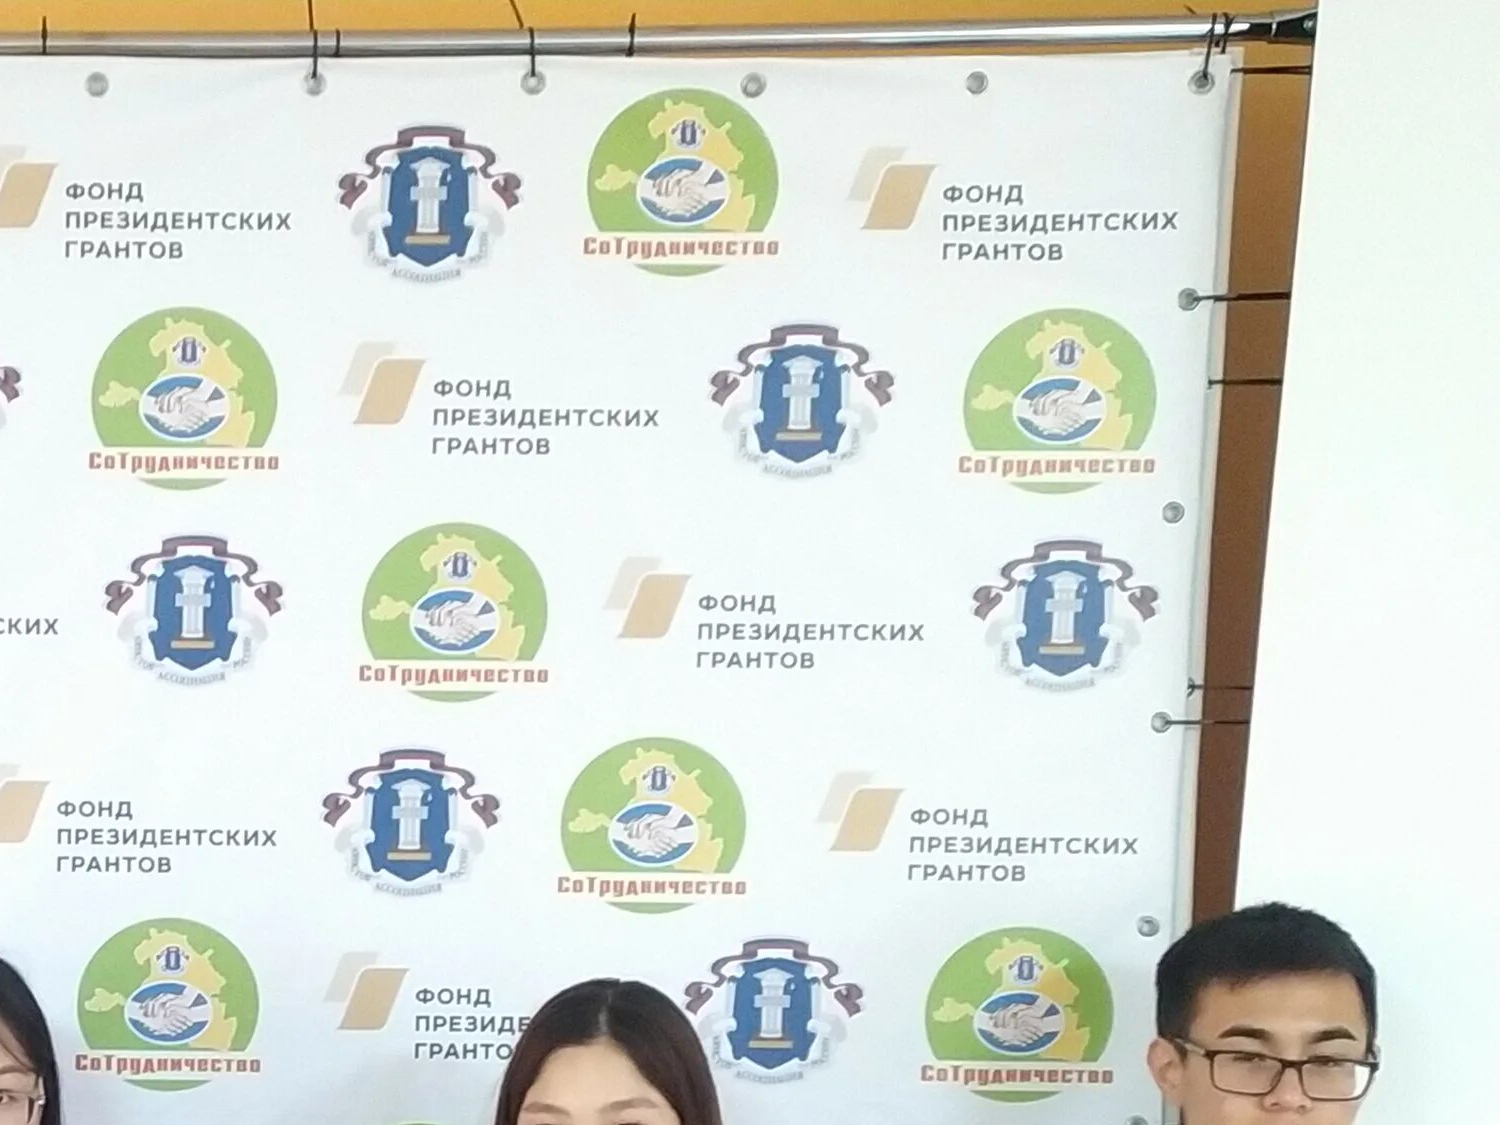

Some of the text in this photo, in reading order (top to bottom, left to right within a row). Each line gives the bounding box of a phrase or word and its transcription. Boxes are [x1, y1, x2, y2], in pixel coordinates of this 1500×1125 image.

[65, 181, 144, 204] ФОНД
[942, 184, 1024, 206] ФОНД
[65, 210, 292, 233] ПРЕЗИДЕНТСКИХ
[942, 211, 1179, 236] ПРЕЗИДЕНТСКИХ
[64, 240, 183, 260] ГРАНТОВ
[583, 236, 779, 259] СоТрудничество
[942, 242, 1064, 262] ГРАНТОВ
[433, 379, 512, 401] ФОНД
[432, 408, 659, 430] ПРЕЗИДЕНТСКИХ
[431, 437, 551, 456] ГРАНТОВ
[88, 451, 279, 474] СоТрудничество
[958, 454, 1156, 477] СоТрудничество
[698, 594, 777, 616] ФОНД
[697, 622, 925, 644] ПРЕЗИДЕНТСКИХ
[696, 651, 815, 669] ГРАНТОВ
[358, 664, 549, 687] СоТрудничество
[56, 800, 134, 821] ФОНД
[910, 808, 989, 829] ФОНД
[57, 828, 277, 849] ПРЕЗИДЕНТСКИХ
[909, 836, 1138, 857] ПРЕЗИДЕНТСКИХ
[56, 855, 172, 874] ГРАНТОВ
[907, 863, 1026, 882] ГРАНТОВ
[557, 876, 747, 899] СоТрудничество
[415, 987, 492, 1008] ФОНД
[74, 1053, 261, 1076] СоТрудничество
[920, 1063, 1115, 1086] СоТрудничество
